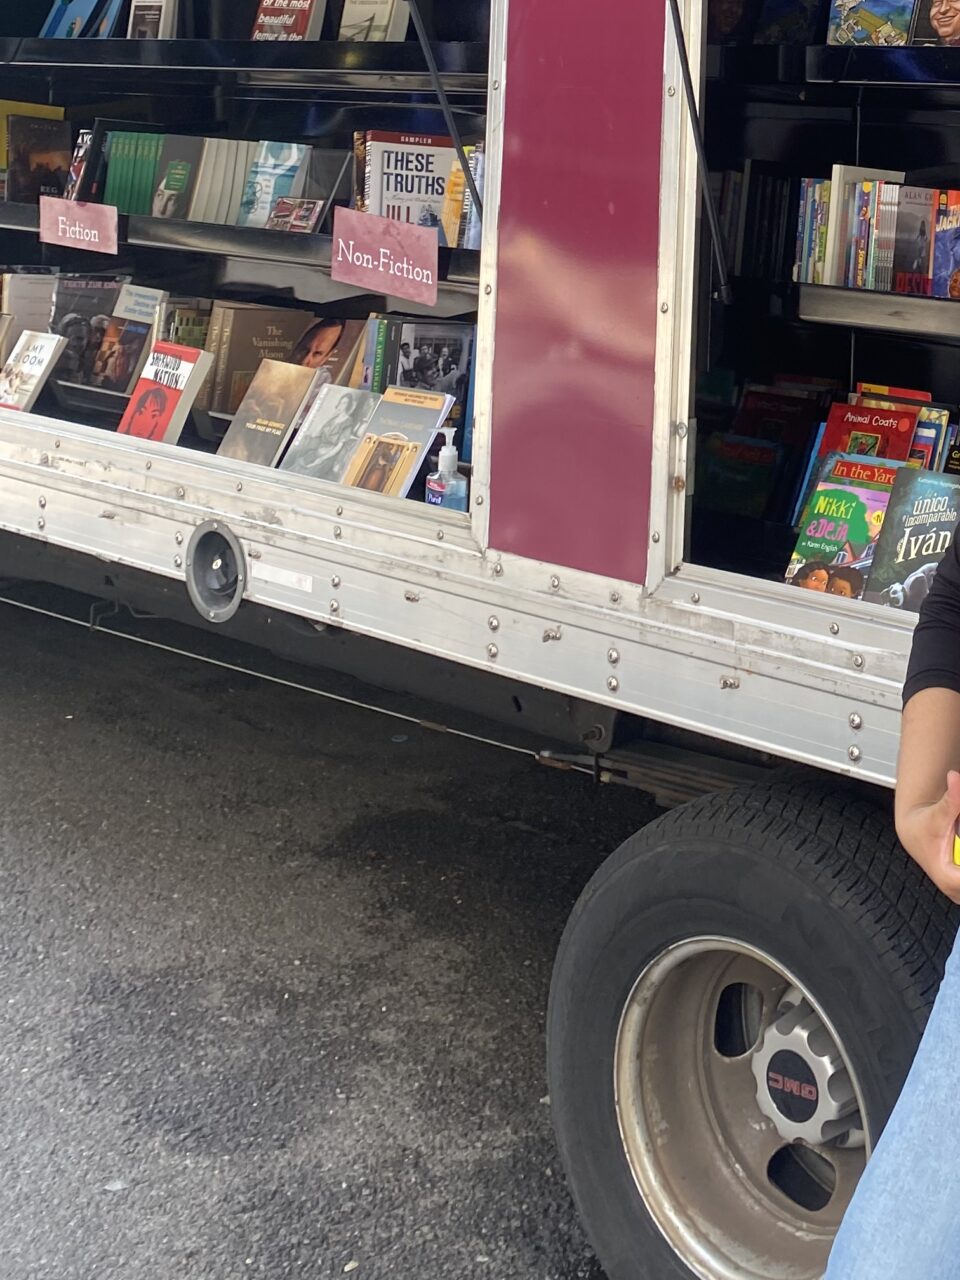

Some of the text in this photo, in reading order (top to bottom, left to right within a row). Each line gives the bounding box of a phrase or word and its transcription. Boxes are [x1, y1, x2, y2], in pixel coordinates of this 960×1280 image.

[290, 0, 311, 8] most
[258, 13, 296, 25] beautiful
[401, 136, 432, 144] SAMPLER
[383, 150, 435, 173] THESE
[383, 172, 445, 196] TRUTHS
[58, 216, 99, 242] Fiction
[336, 237, 434, 286] Non-Fiction
[266, 326, 282, 336] The
[252, 337, 294, 349] Vanishing
[844, 412, 898, 428] Animal Coats
[834, 462, 849, 476] In
[850, 466, 872, 480] the
[814, 496, 856, 519] Nikki
[913, 493, 949, 515] único
[807, 541, 838, 552] Karen English
[895, 527, 951, 564] Iván
[768, 1072, 817, 1100] GMC
